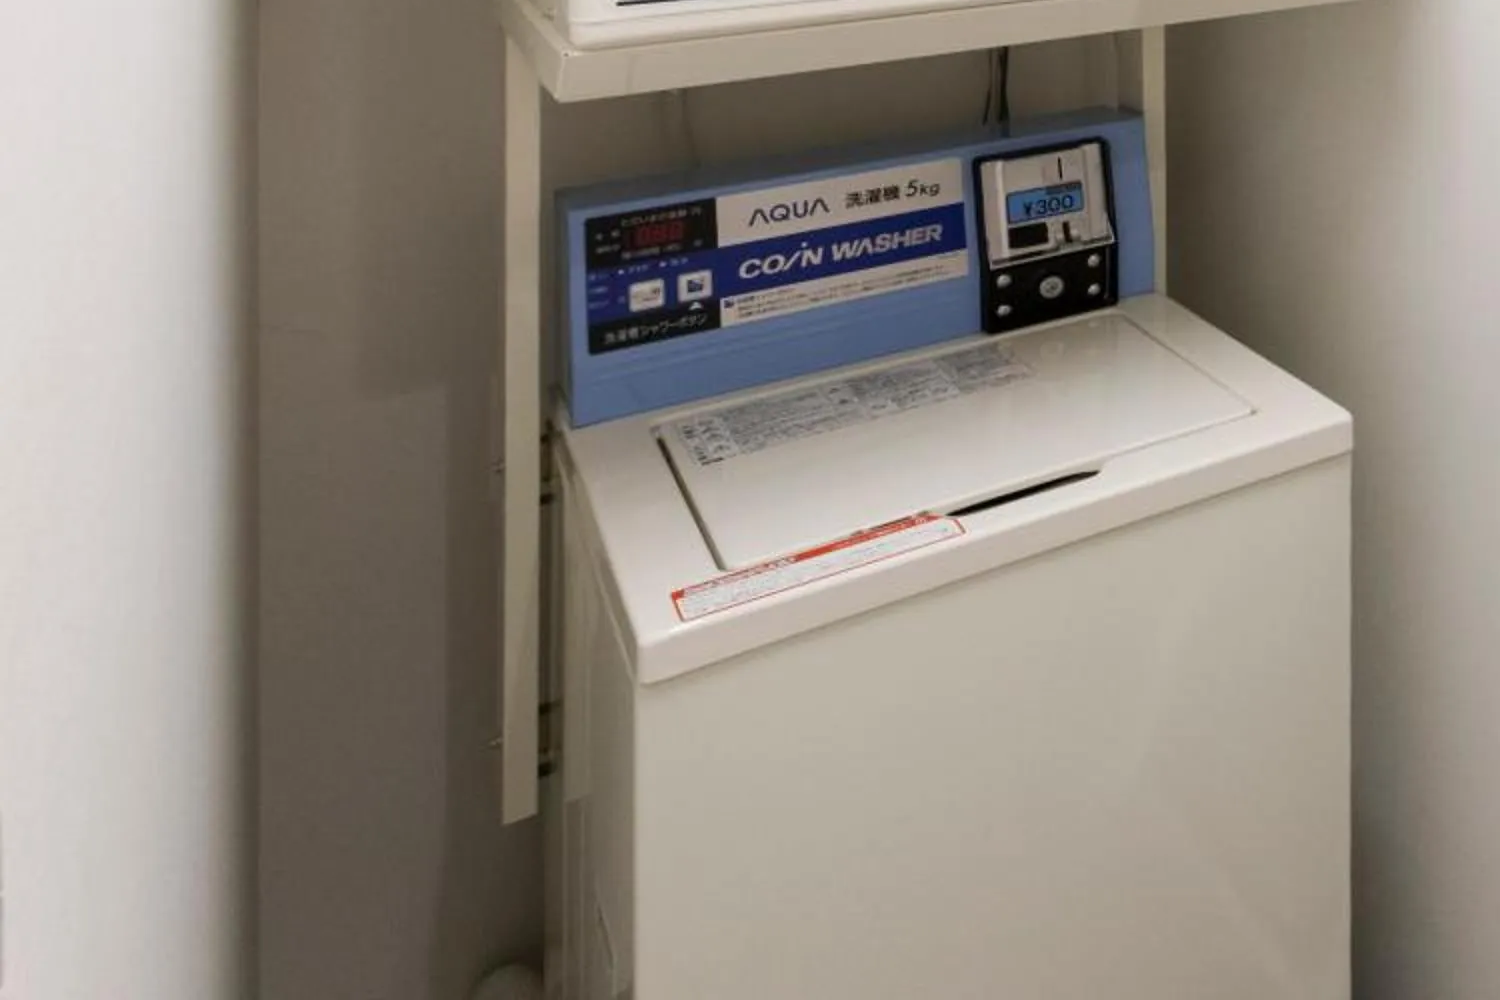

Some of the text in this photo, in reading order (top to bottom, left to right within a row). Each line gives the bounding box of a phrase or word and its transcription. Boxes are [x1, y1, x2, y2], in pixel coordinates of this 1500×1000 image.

[749, 197, 830, 227] AQUA
[845, 185, 900, 210] 洗濯機
[832, 223, 944, 262] WASHER
